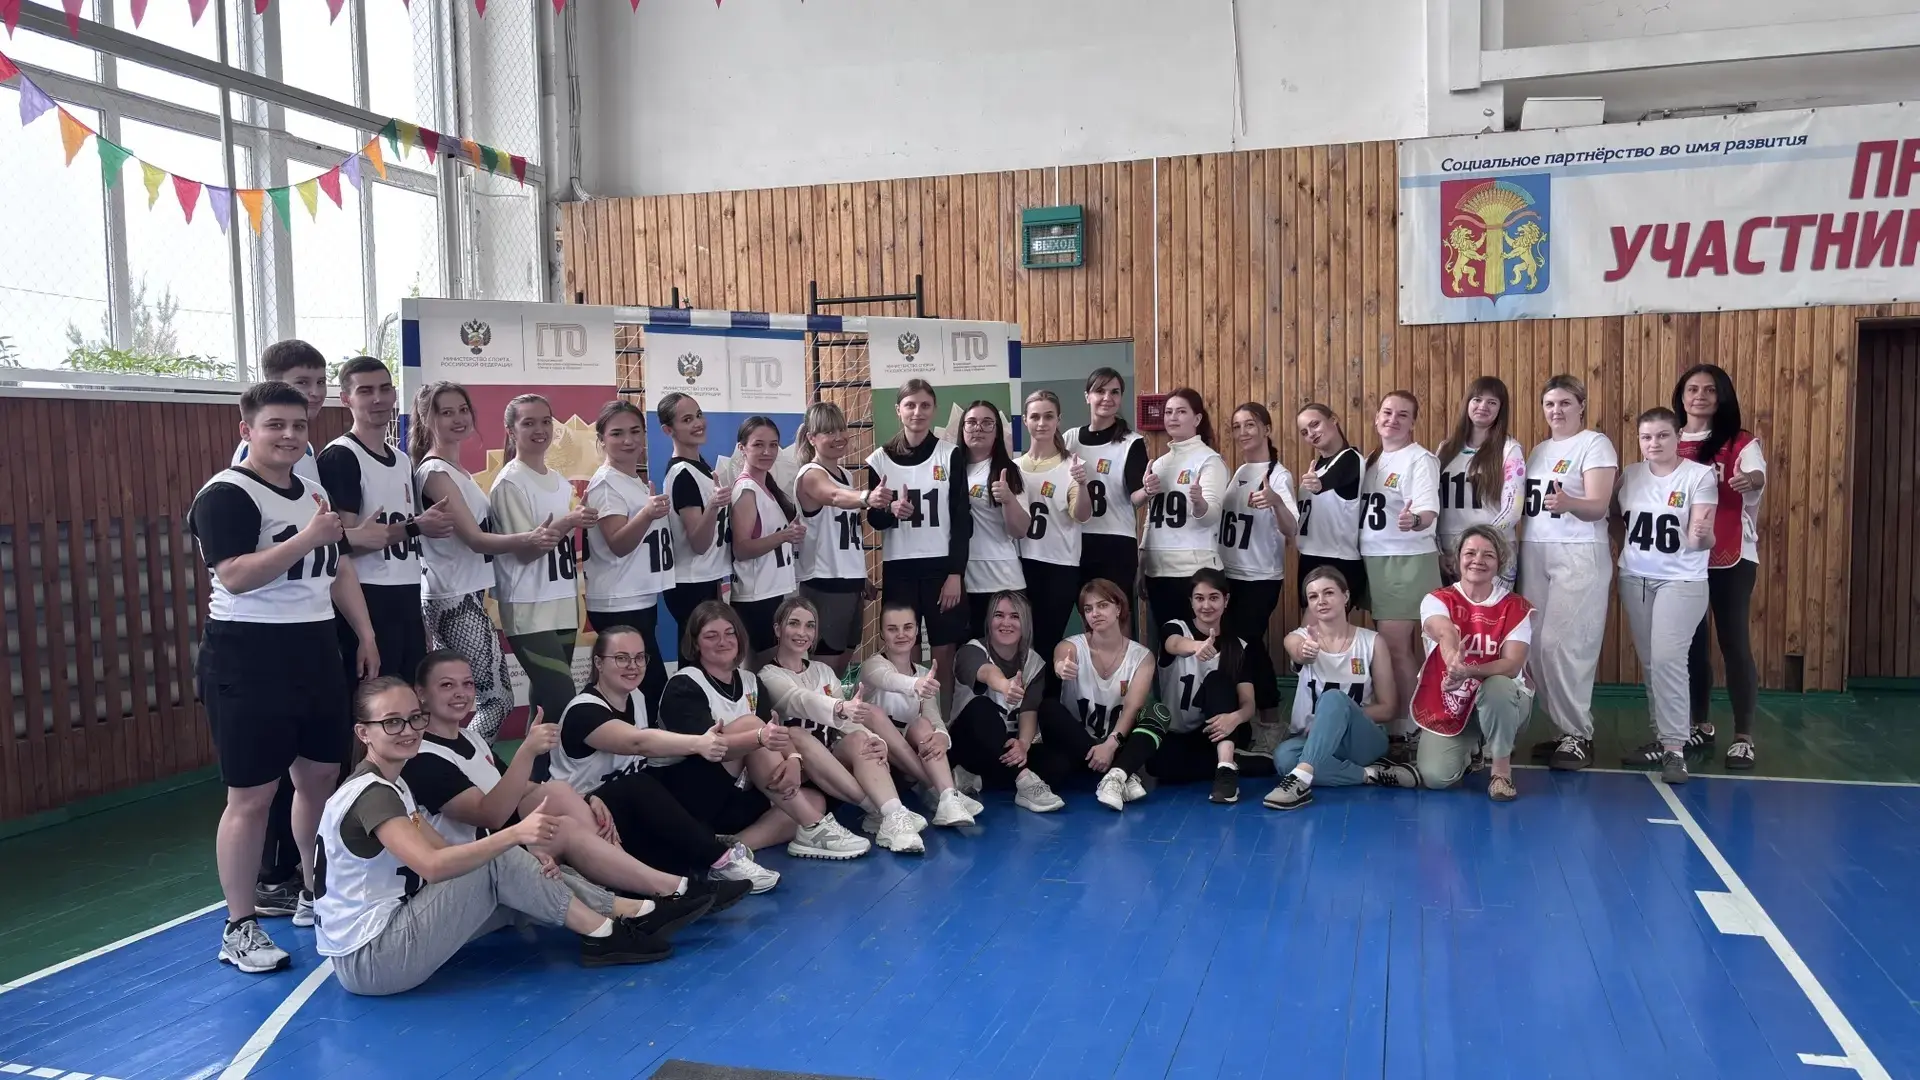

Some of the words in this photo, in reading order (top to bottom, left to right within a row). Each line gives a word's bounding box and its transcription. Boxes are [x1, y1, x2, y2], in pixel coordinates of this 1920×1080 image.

[1441, 154, 1541, 172] Социальное
[1544, 146, 1655, 167] партнёрство
[1659, 143, 1681, 157] во
[1685, 141, 1721, 154] имя
[1723, 134, 1809, 156] развития
[1034, 238, 1076, 252] ВЫХОД
[535, 322, 588, 358] ГТО
[951, 330, 989, 361] ГТО
[740, 355, 783, 389] ГТО
